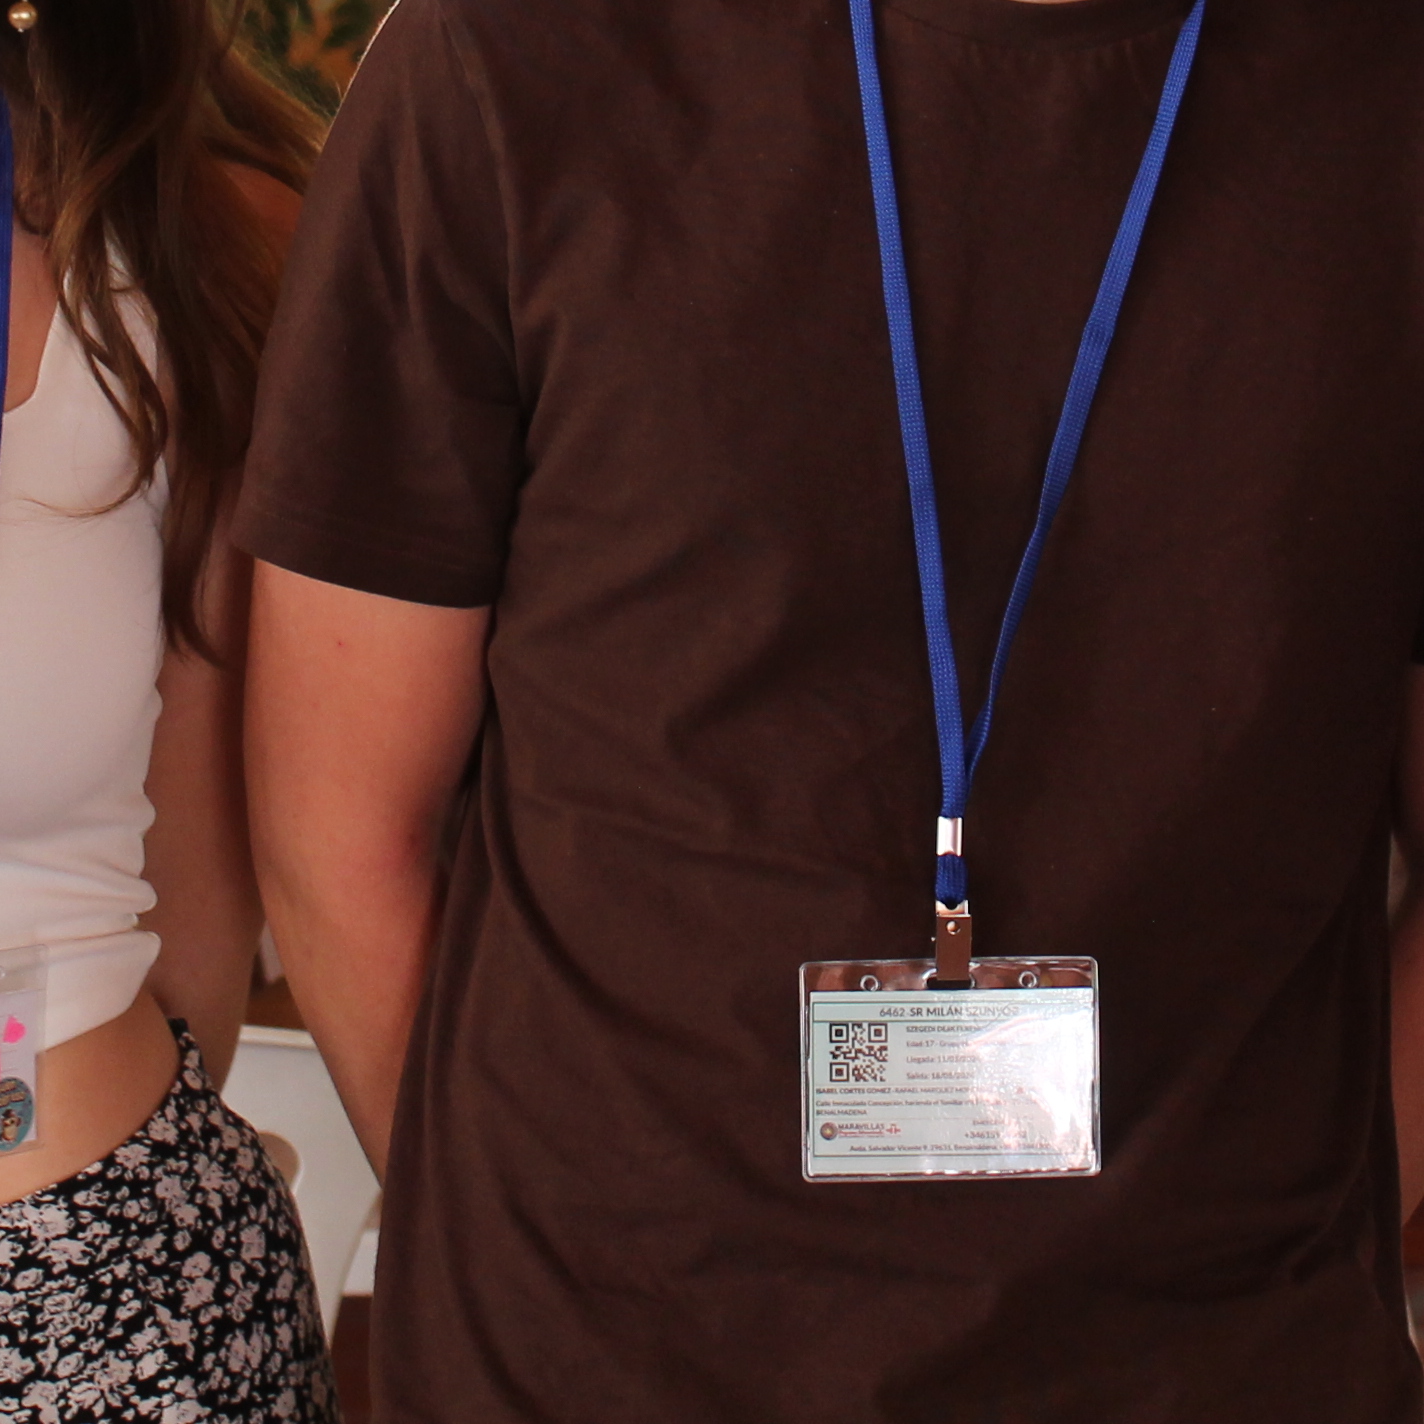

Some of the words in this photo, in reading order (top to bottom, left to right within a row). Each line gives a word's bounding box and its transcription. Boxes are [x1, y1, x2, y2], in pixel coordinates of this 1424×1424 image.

[879, 1006, 906, 1017] 6462
[909, 1006, 923, 1017] SR
[926, 1005, 963, 1017] MILÁN
